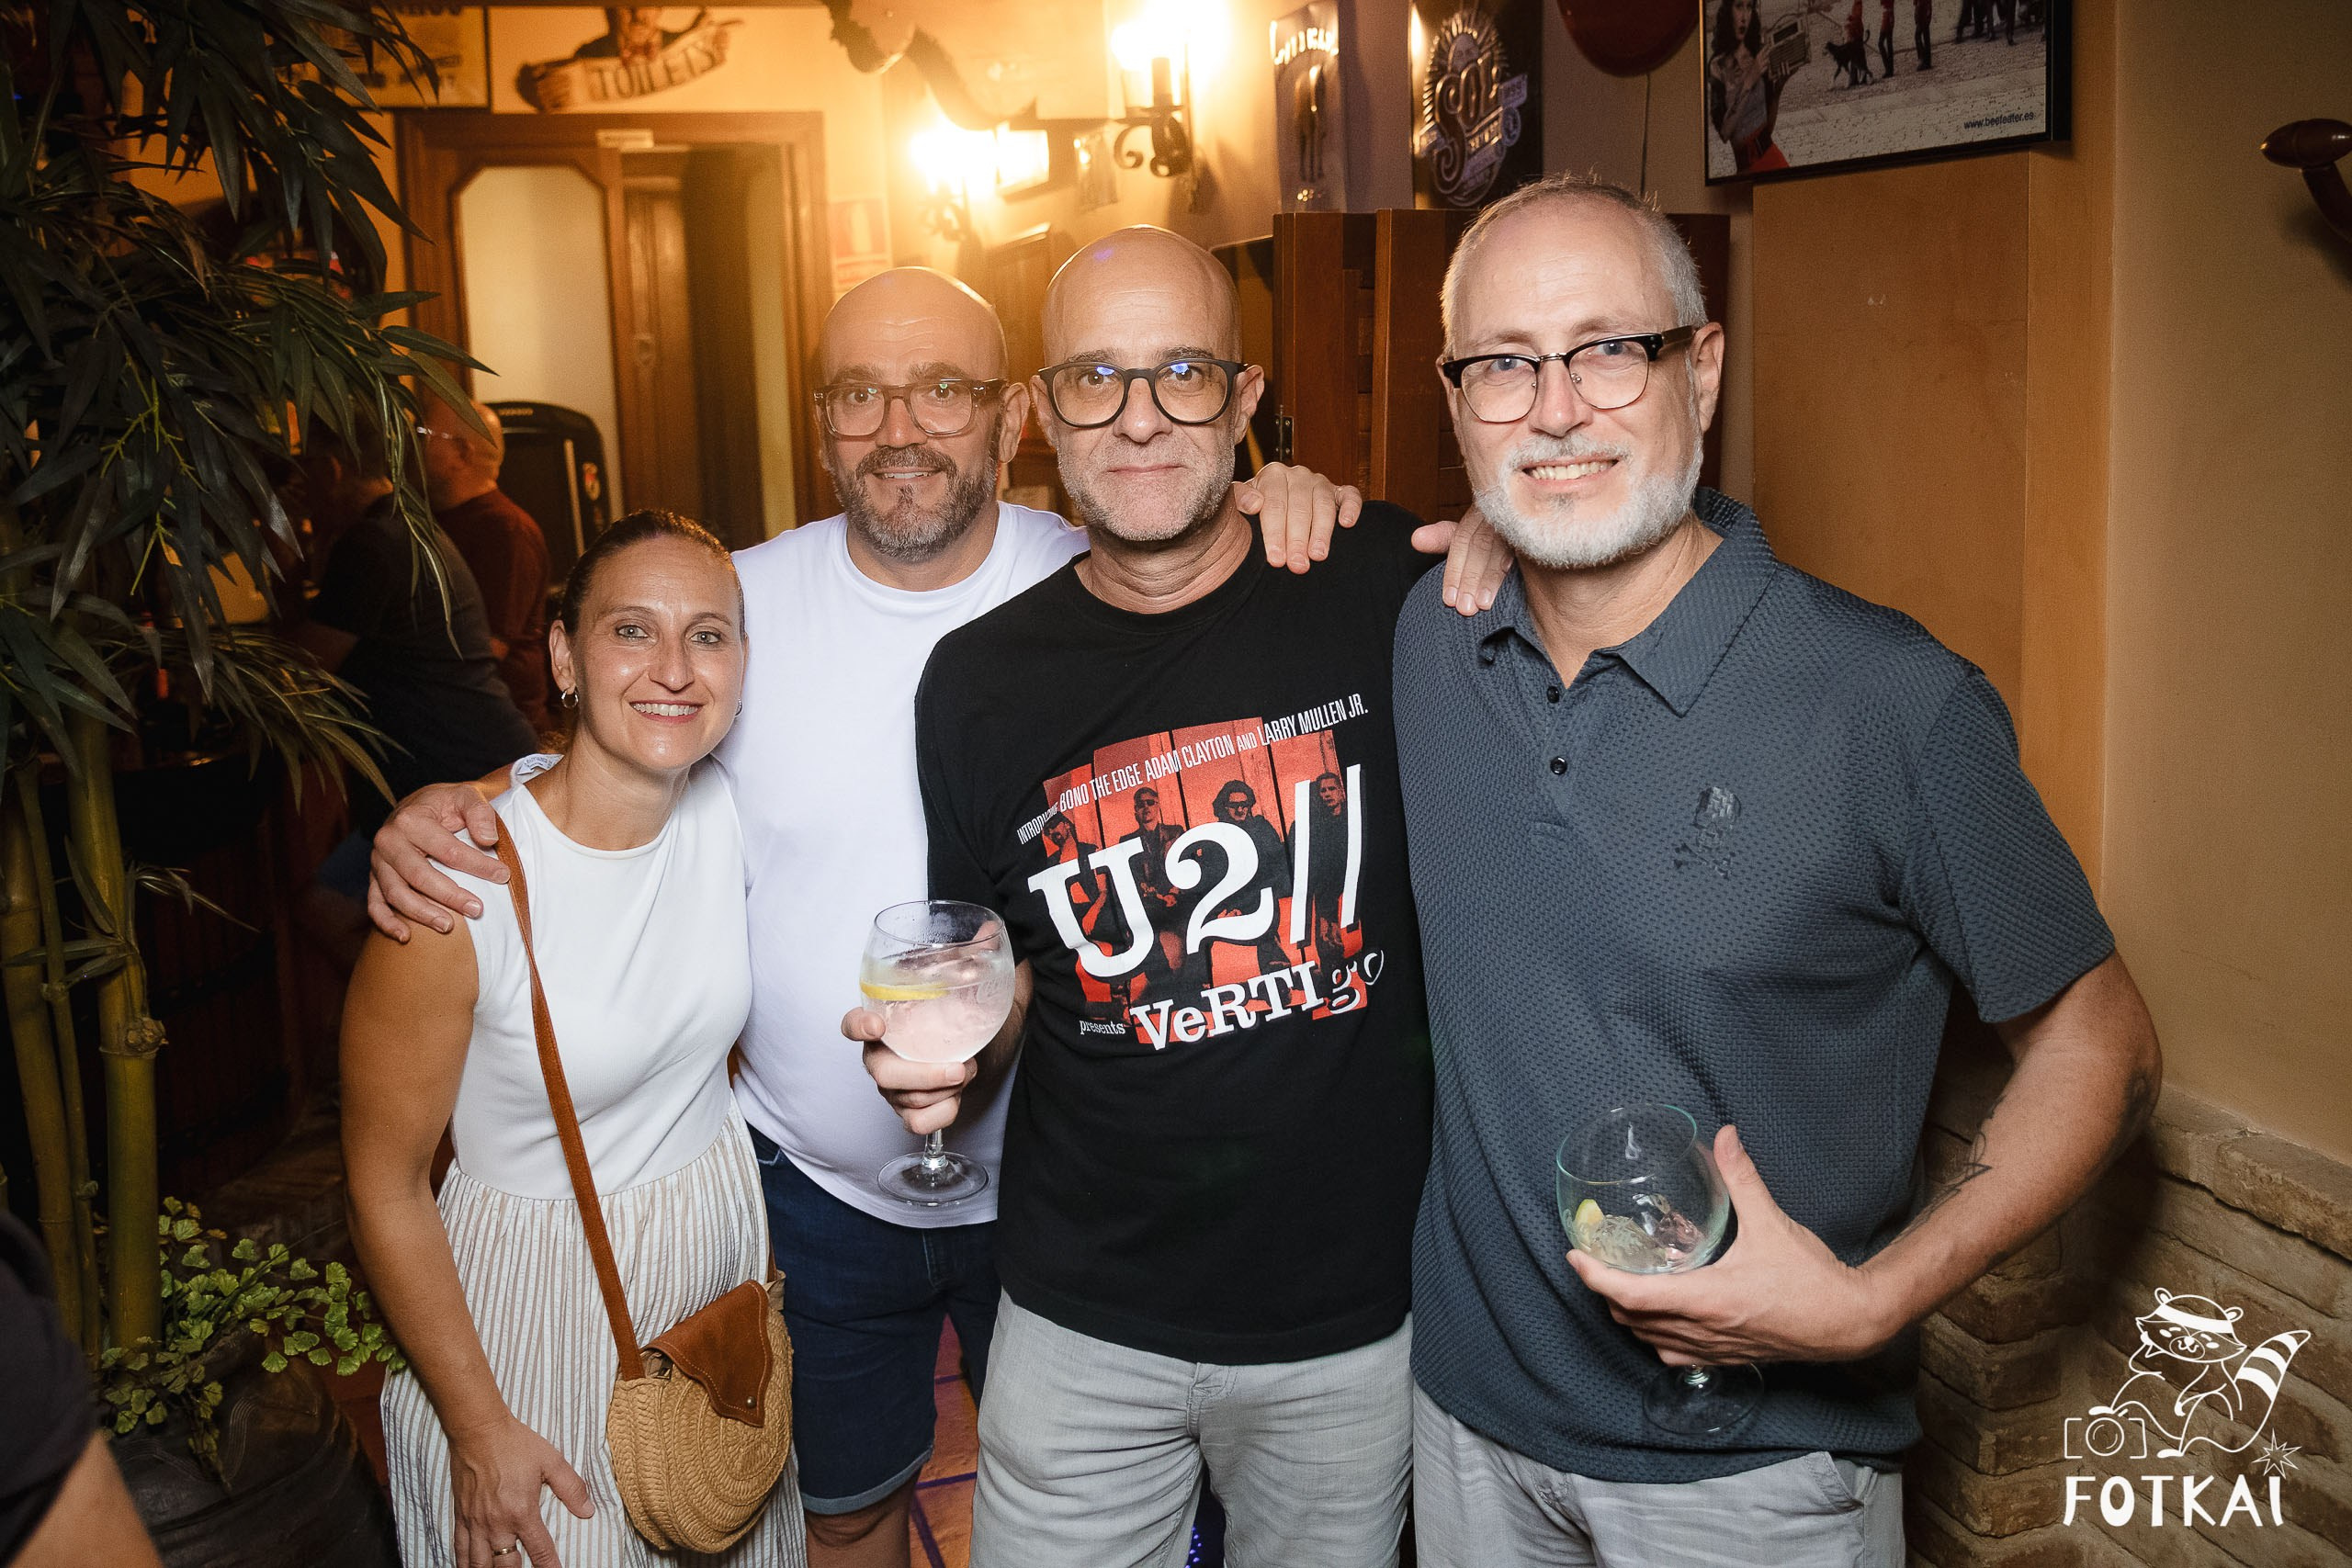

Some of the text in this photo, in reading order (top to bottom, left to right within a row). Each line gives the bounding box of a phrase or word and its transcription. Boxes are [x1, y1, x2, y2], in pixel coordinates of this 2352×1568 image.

[590, 41, 717, 101] TOILETS
[1430, 51, 1502, 195] SOL
[1963, 111, 2034, 130] www.beefeater.es
[1059, 783, 1090, 812] BONO
[1089, 773, 1113, 800] THE
[1111, 762, 1143, 793] EDGE
[1144, 750, 1182, 782] ADAM
[1182, 734, 1236, 770] CLAYTON
[1236, 731, 1258, 752] AND
[1256, 716, 1297, 746] LARRY
[1297, 698, 1348, 734] MULLEN
[1348, 693, 1369, 718] JR.
[1079, 1019, 1126, 1036] presents
